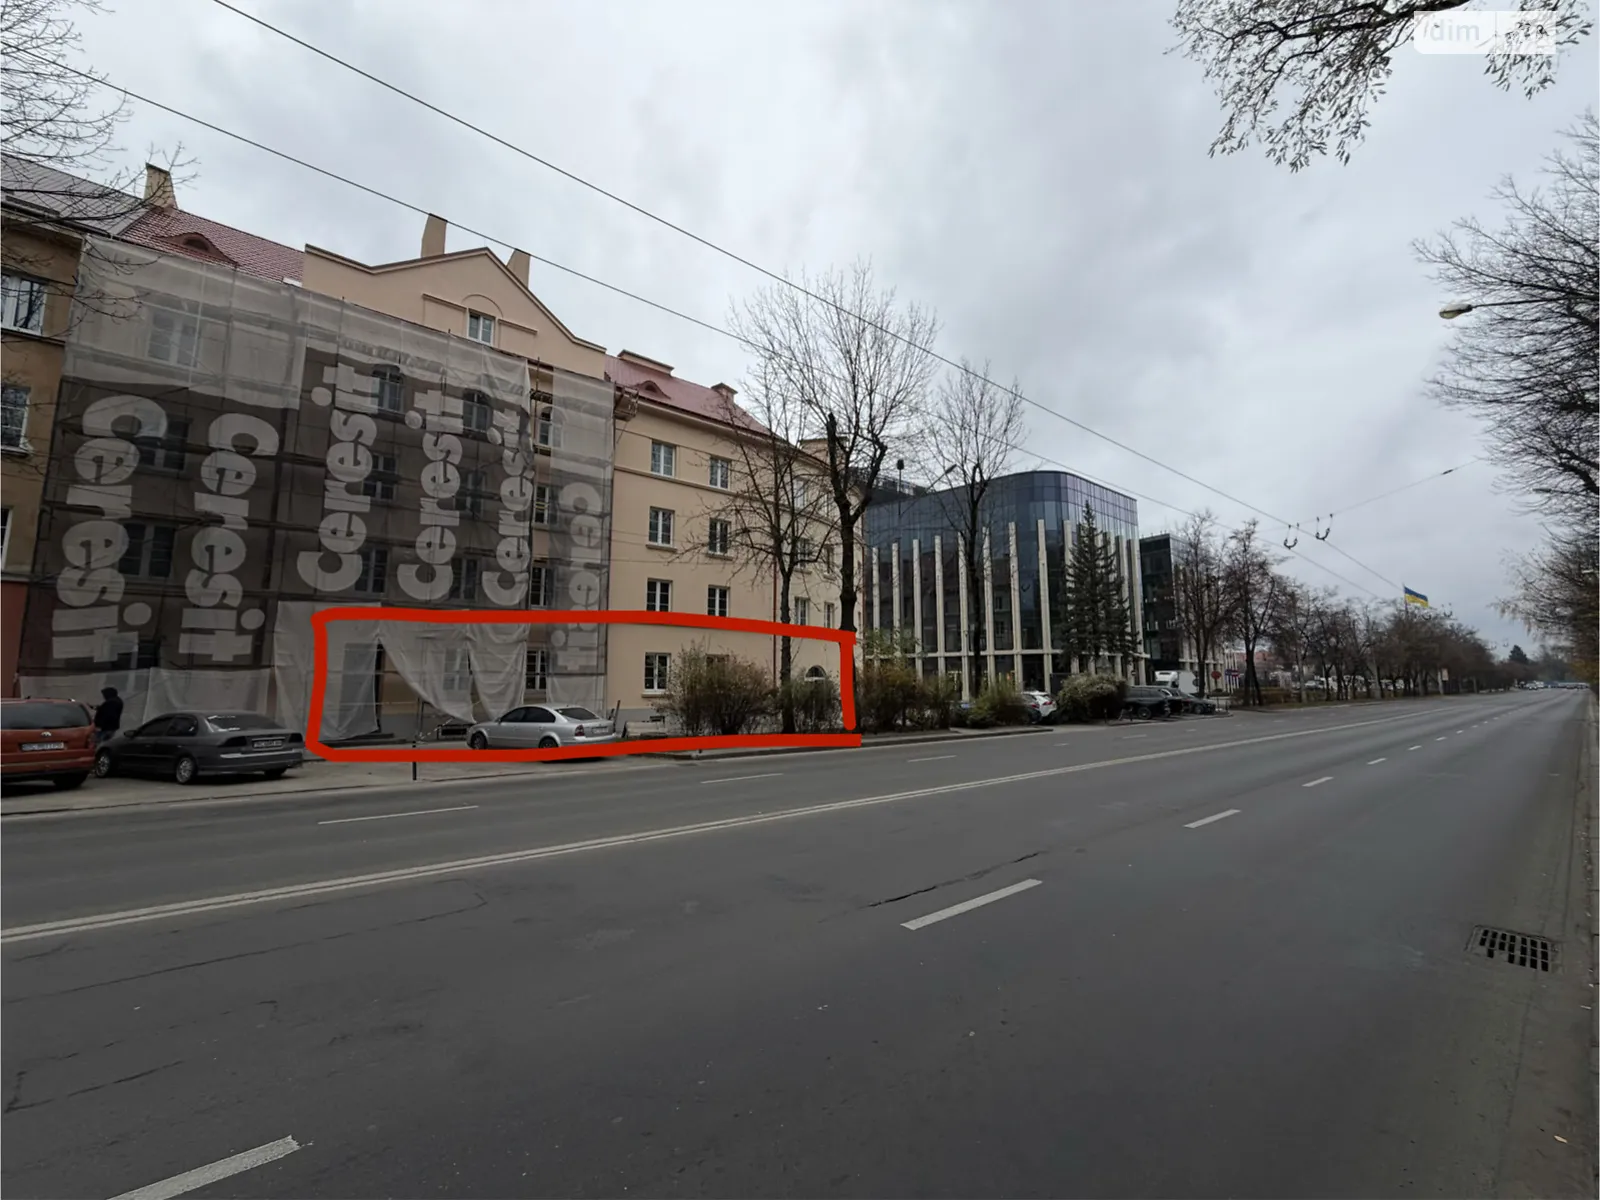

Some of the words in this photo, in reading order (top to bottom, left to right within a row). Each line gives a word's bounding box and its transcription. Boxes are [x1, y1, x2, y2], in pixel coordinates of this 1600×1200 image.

[52, 395, 168, 662] Ceresit
[179, 413, 279, 661] Ceresit
[297, 362, 377, 592] Ceresit
[397, 390, 463, 600] Ceresit
[482, 408, 535, 605] Ceresit
